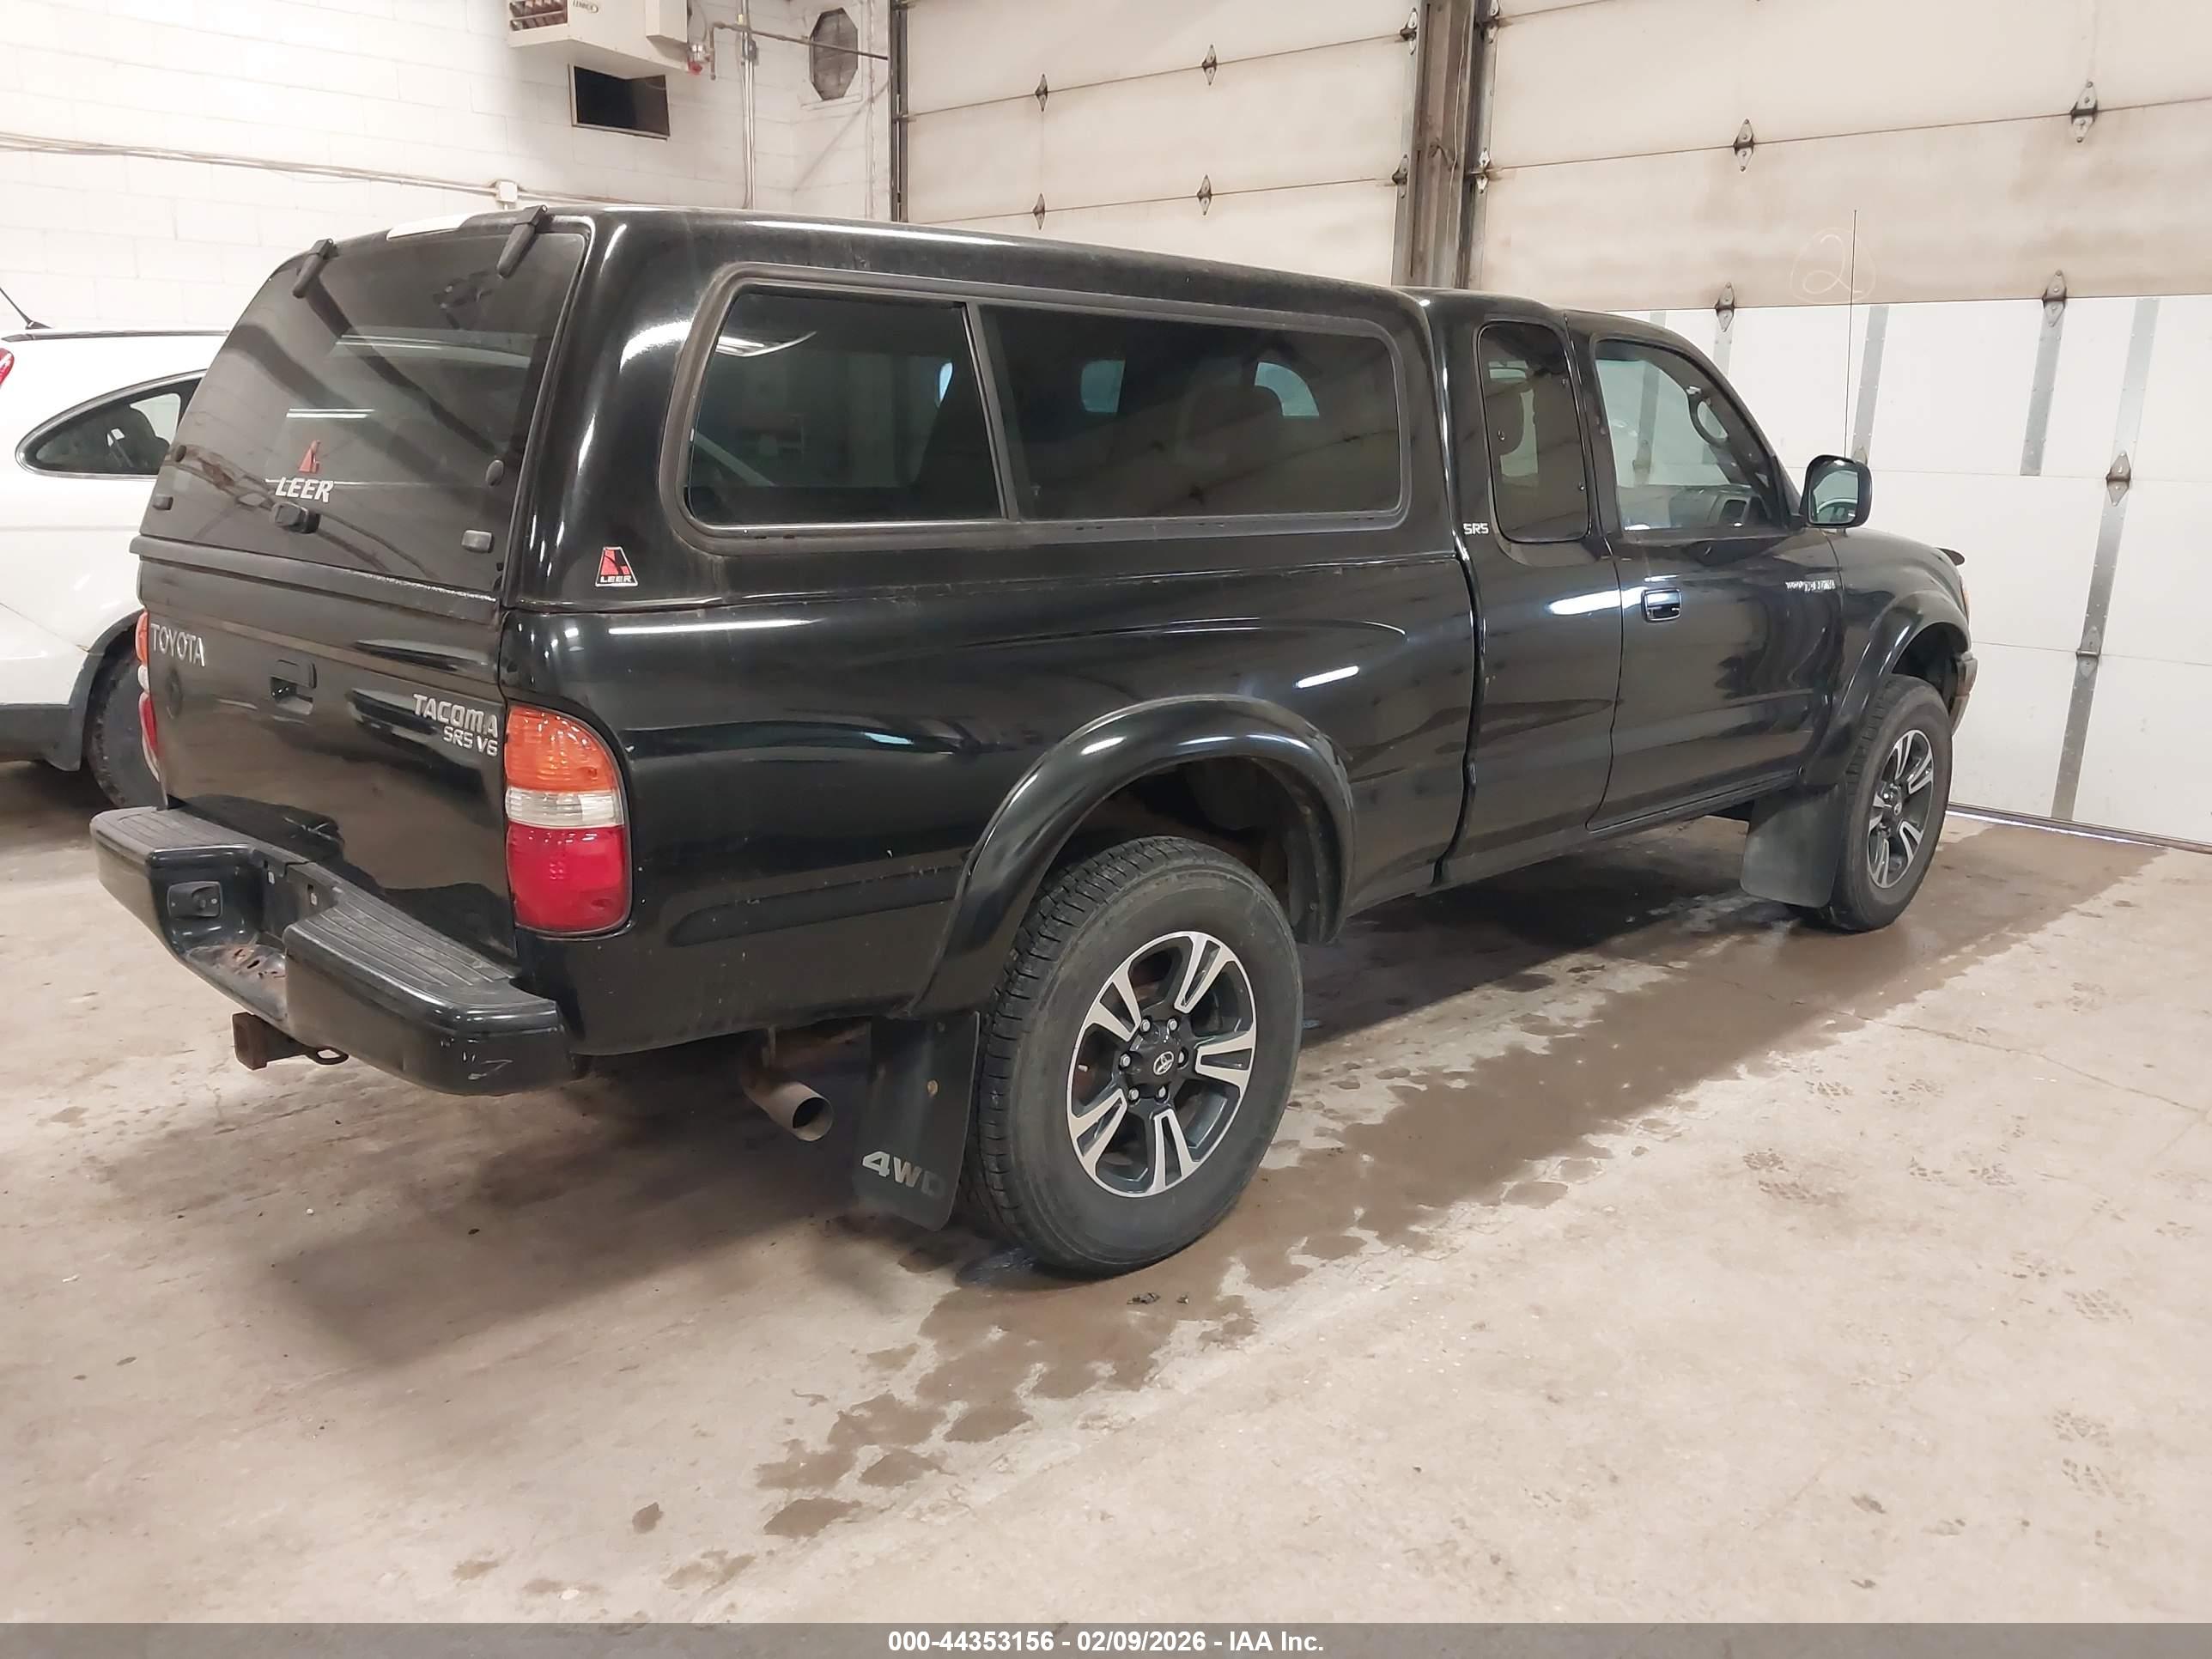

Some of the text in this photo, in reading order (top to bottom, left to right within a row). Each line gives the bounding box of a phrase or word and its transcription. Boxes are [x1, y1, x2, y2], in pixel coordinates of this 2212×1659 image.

[275, 477, 334, 502] LEER
[150, 623, 205, 667] TOYOTA
[413, 693, 498, 738] TACOMA
[477, 735, 498, 757] V6
[862, 1151, 947, 1197] 4WD
